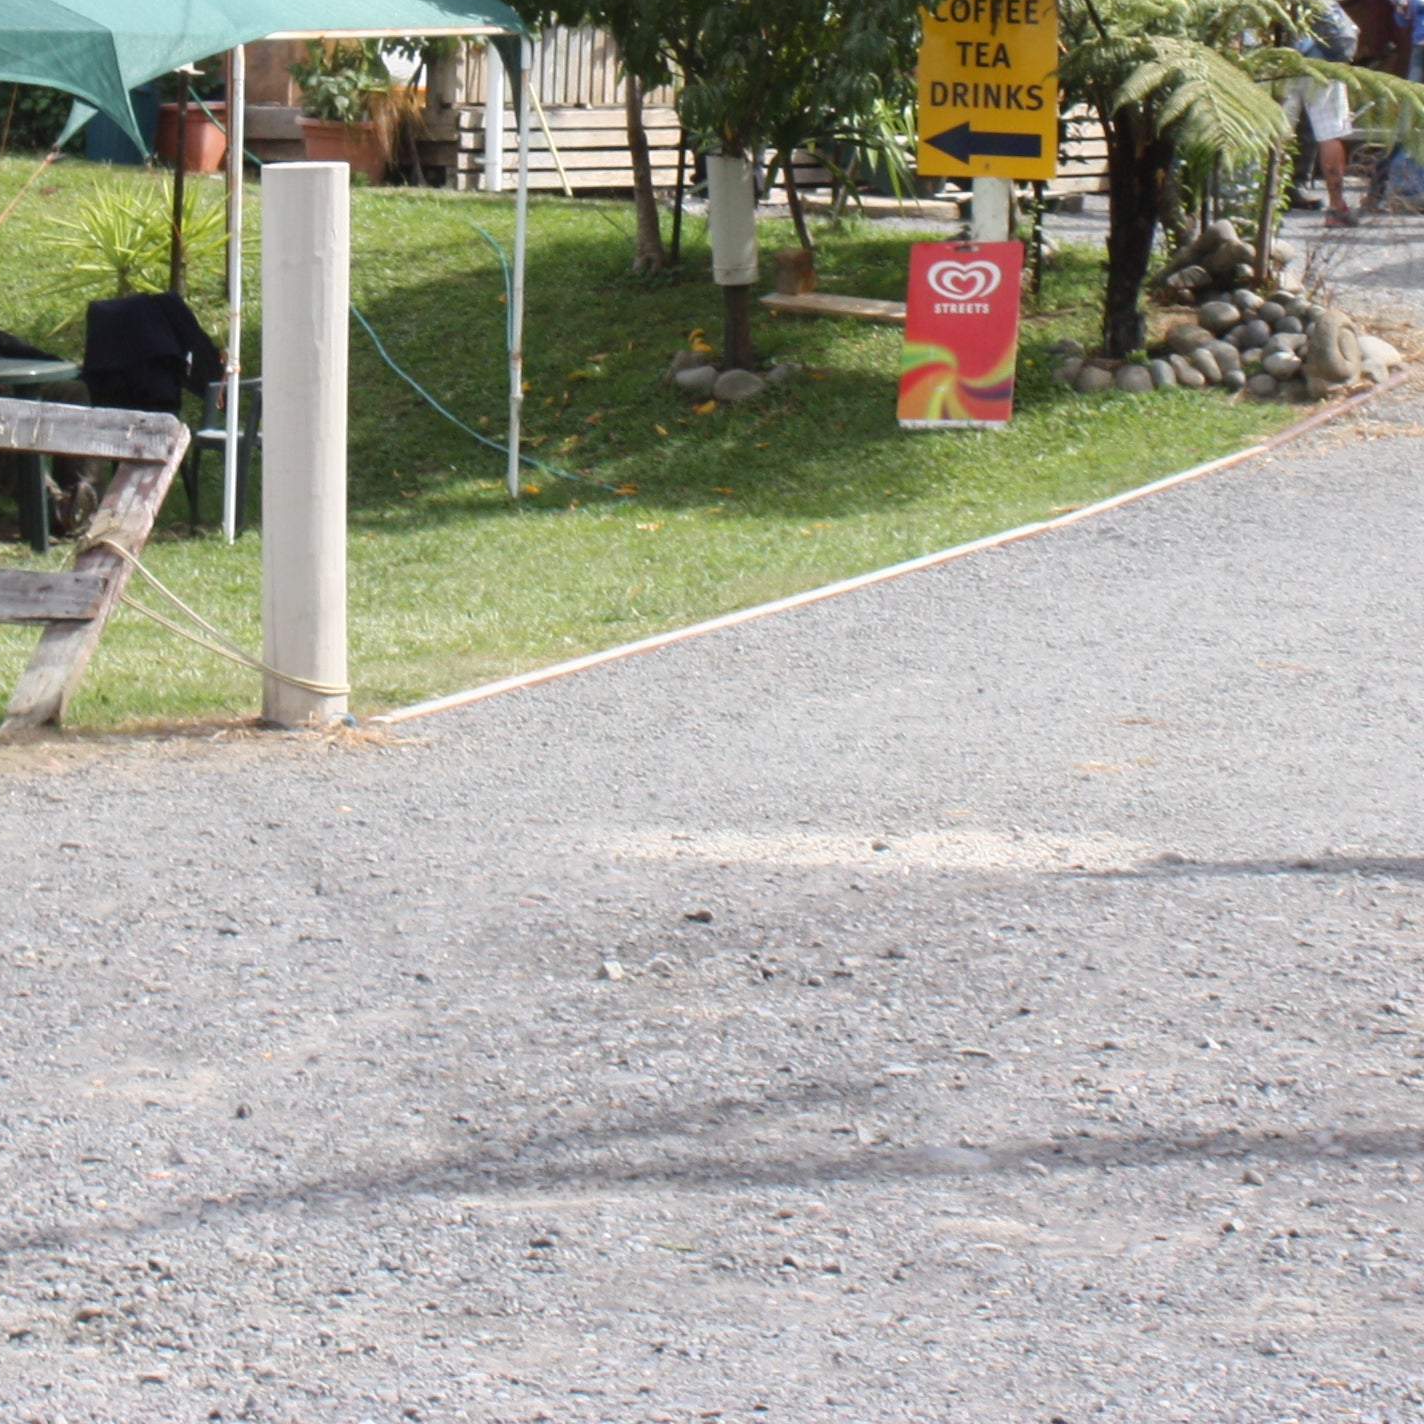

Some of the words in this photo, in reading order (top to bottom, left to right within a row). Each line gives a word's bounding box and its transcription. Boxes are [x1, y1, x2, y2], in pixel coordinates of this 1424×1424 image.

[956, 41, 1011, 68] TEA
[930, 81, 1044, 111] DRINKS
[934, 303, 990, 314] STREETS
